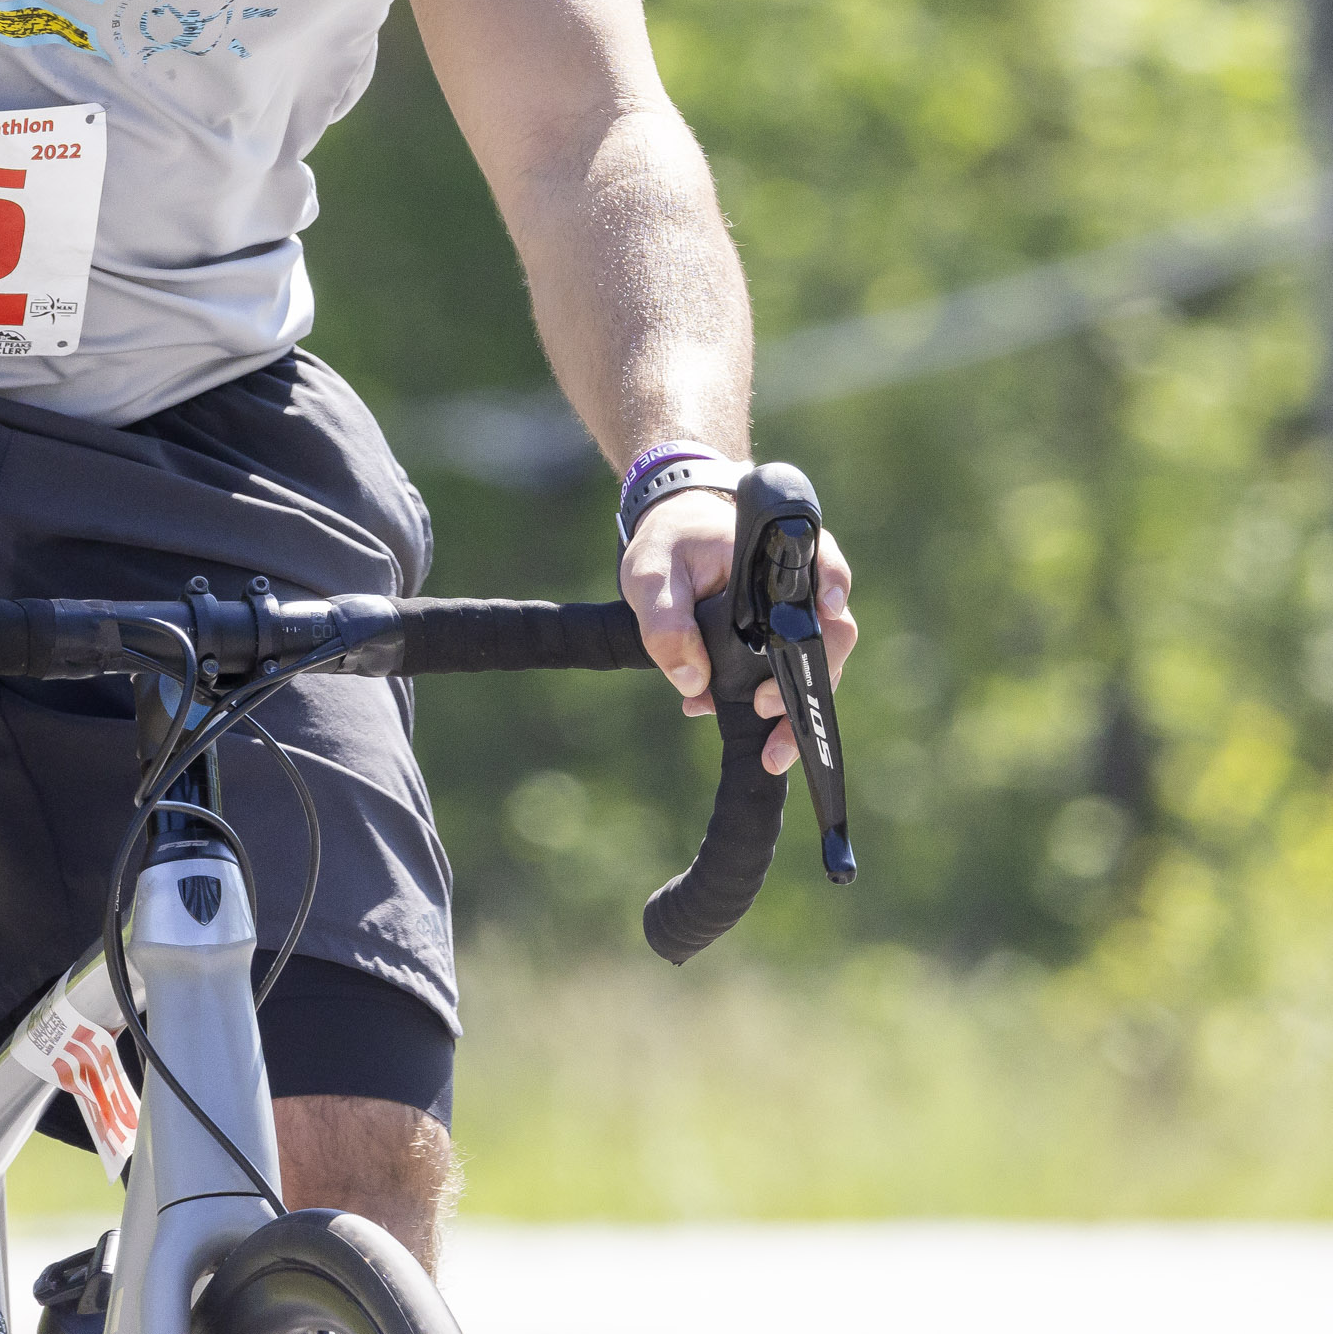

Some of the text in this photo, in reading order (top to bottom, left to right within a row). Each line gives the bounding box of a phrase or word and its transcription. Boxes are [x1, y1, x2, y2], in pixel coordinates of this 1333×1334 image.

[31, 143, 82, 161] 2022
[620, 443, 679, 512] ONE FIGH
[801, 653, 834, 770] SHIMANO 105
[33, 1012, 64, 1051] BICYCLES
